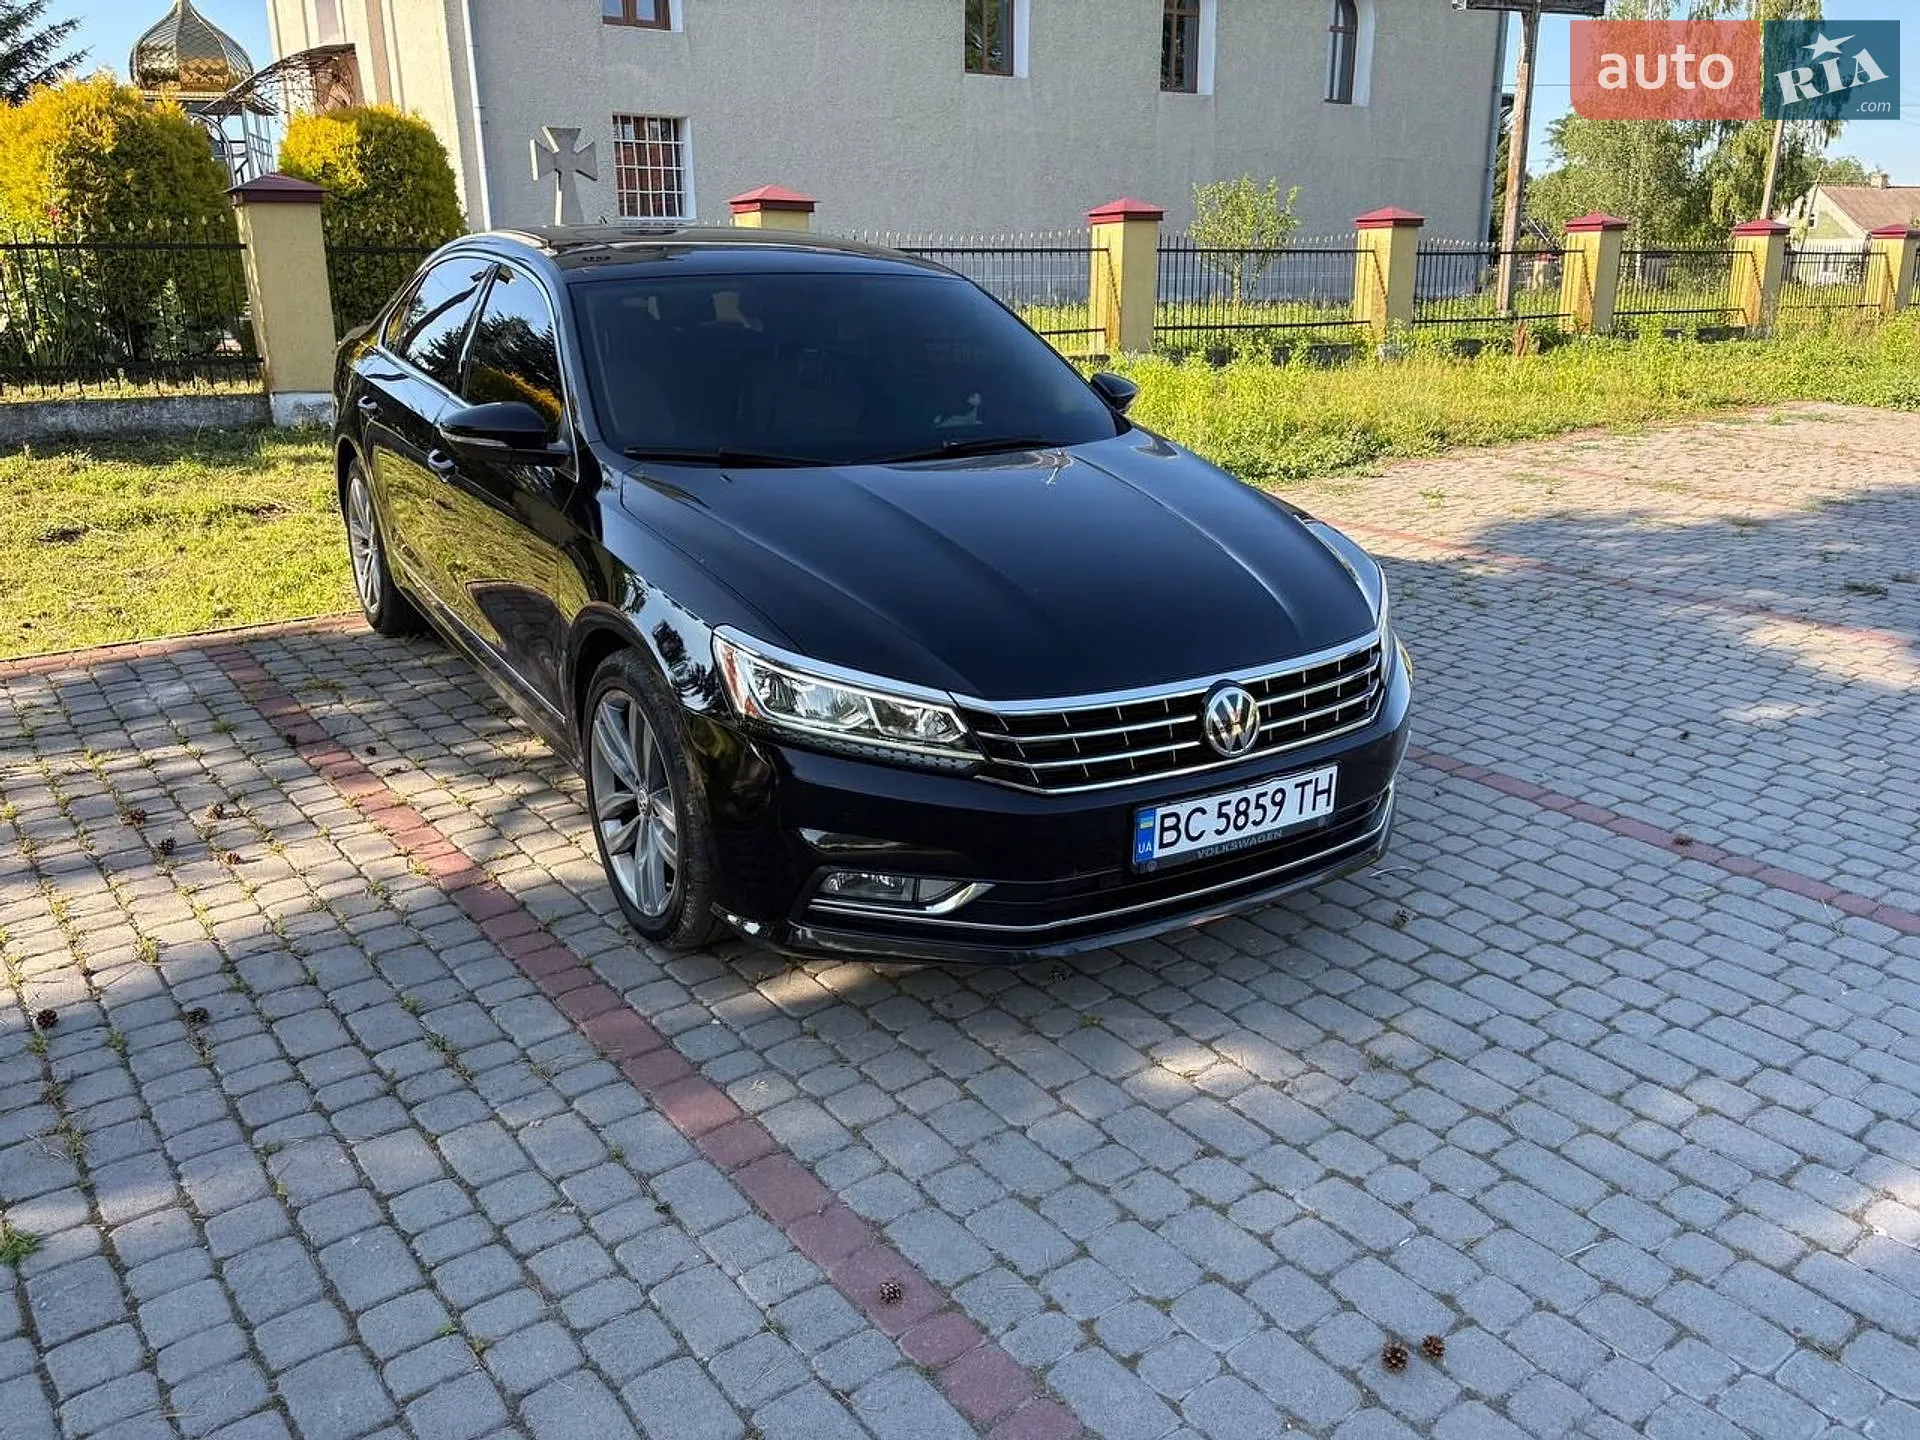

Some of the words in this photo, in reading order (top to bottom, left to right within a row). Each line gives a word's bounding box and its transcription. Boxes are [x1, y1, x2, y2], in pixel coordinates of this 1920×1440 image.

[1158, 806, 1208, 849] BC
[1213, 787, 1286, 836] 5859
[1294, 773, 1334, 815] TH
[1138, 841, 1153, 854] UA
[1196, 830, 1283, 859] VOLKSWAGEN
